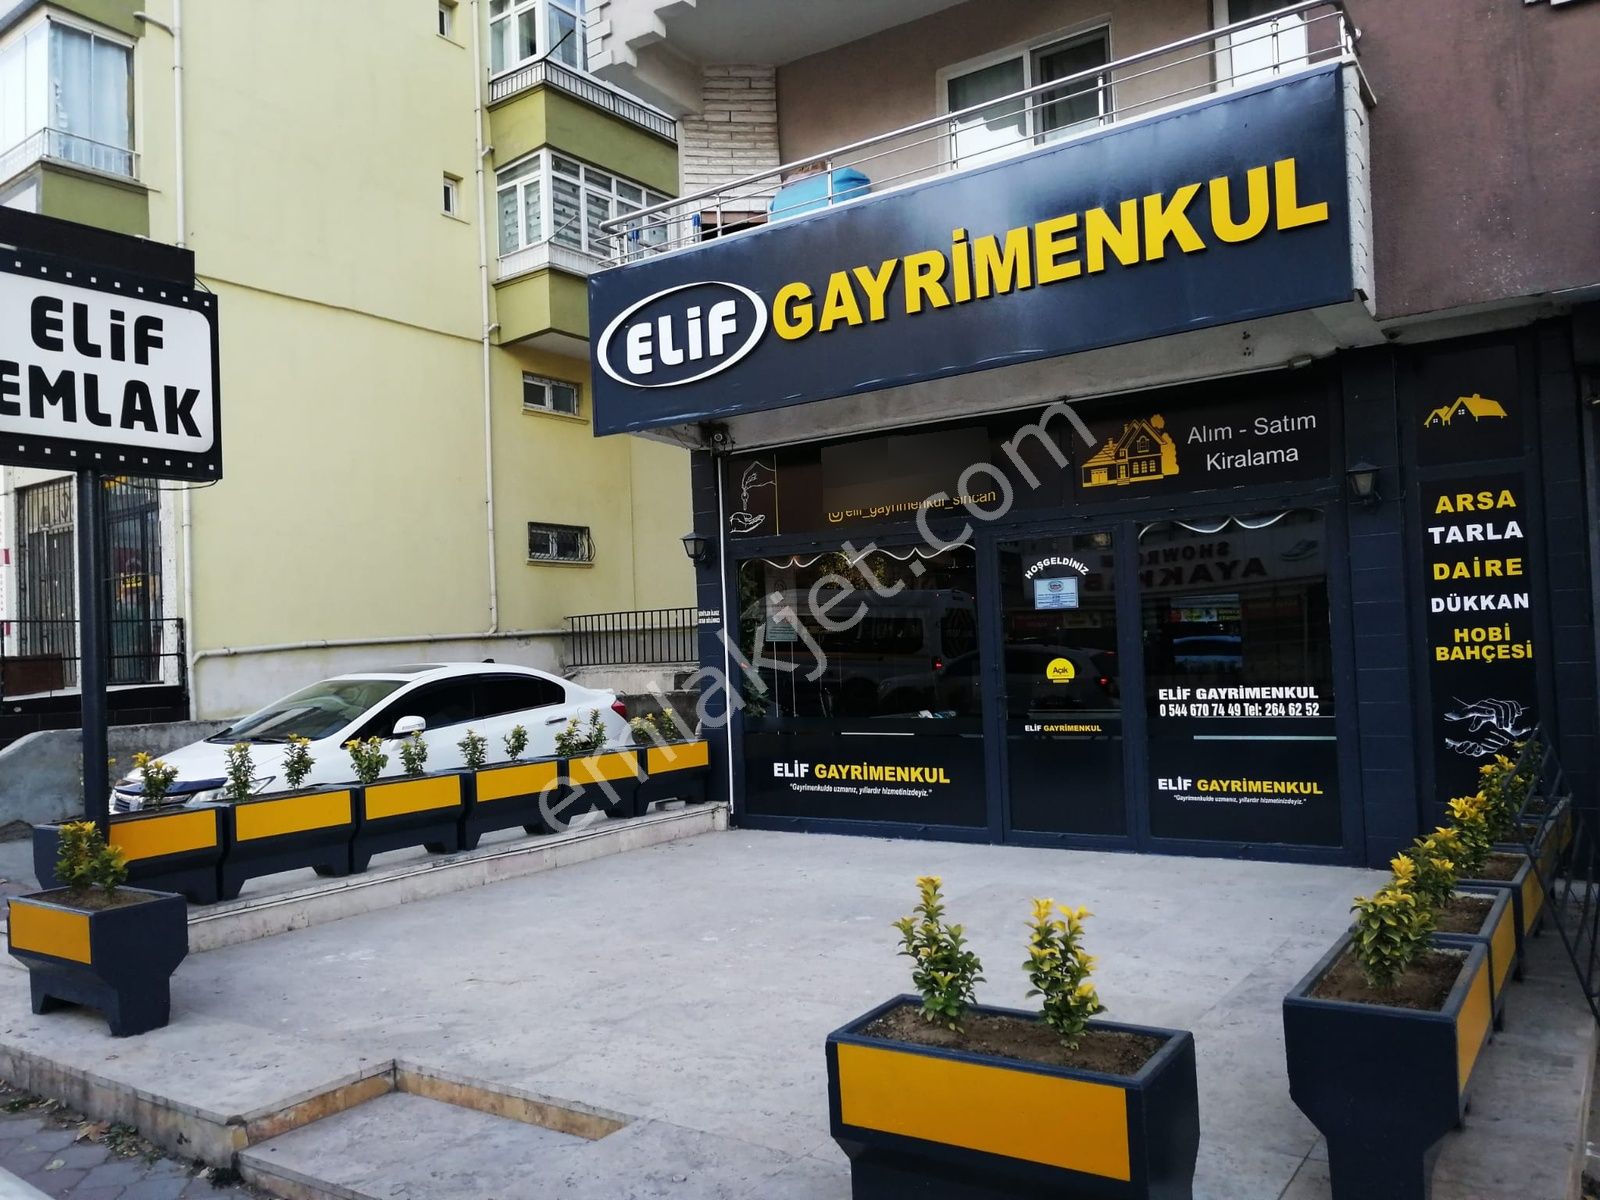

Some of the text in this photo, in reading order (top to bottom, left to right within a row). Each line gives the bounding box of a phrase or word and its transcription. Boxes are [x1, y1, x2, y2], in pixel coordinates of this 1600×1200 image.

[772, 157, 1329, 341] GAYRİMENKUL
[0, 359, 202, 438] EMLAK
[1253, 413, 1317, 436] Satım
[1206, 447, 1299, 471] Kiralama
[1434, 489, 1517, 514] ARSA
[1428, 520, 1524, 544] TARLA
[1433, 556, 1523, 580] DAİRE
[1431, 593, 1529, 613] DÜKKAN
[1454, 622, 1511, 643] HOBİ
[1435, 640, 1533, 664] BAHÇESİ
[1158, 685, 1319, 700] ELİF GAYRİMENKUL
[1160, 703, 1320, 717] 0 544 670 74 49 Tel: 264 62 52
[773, 759, 950, 783] ELİF GAYRİMENKUL
[1158, 776, 1323, 794] ELİF GAYRİMENKUL
